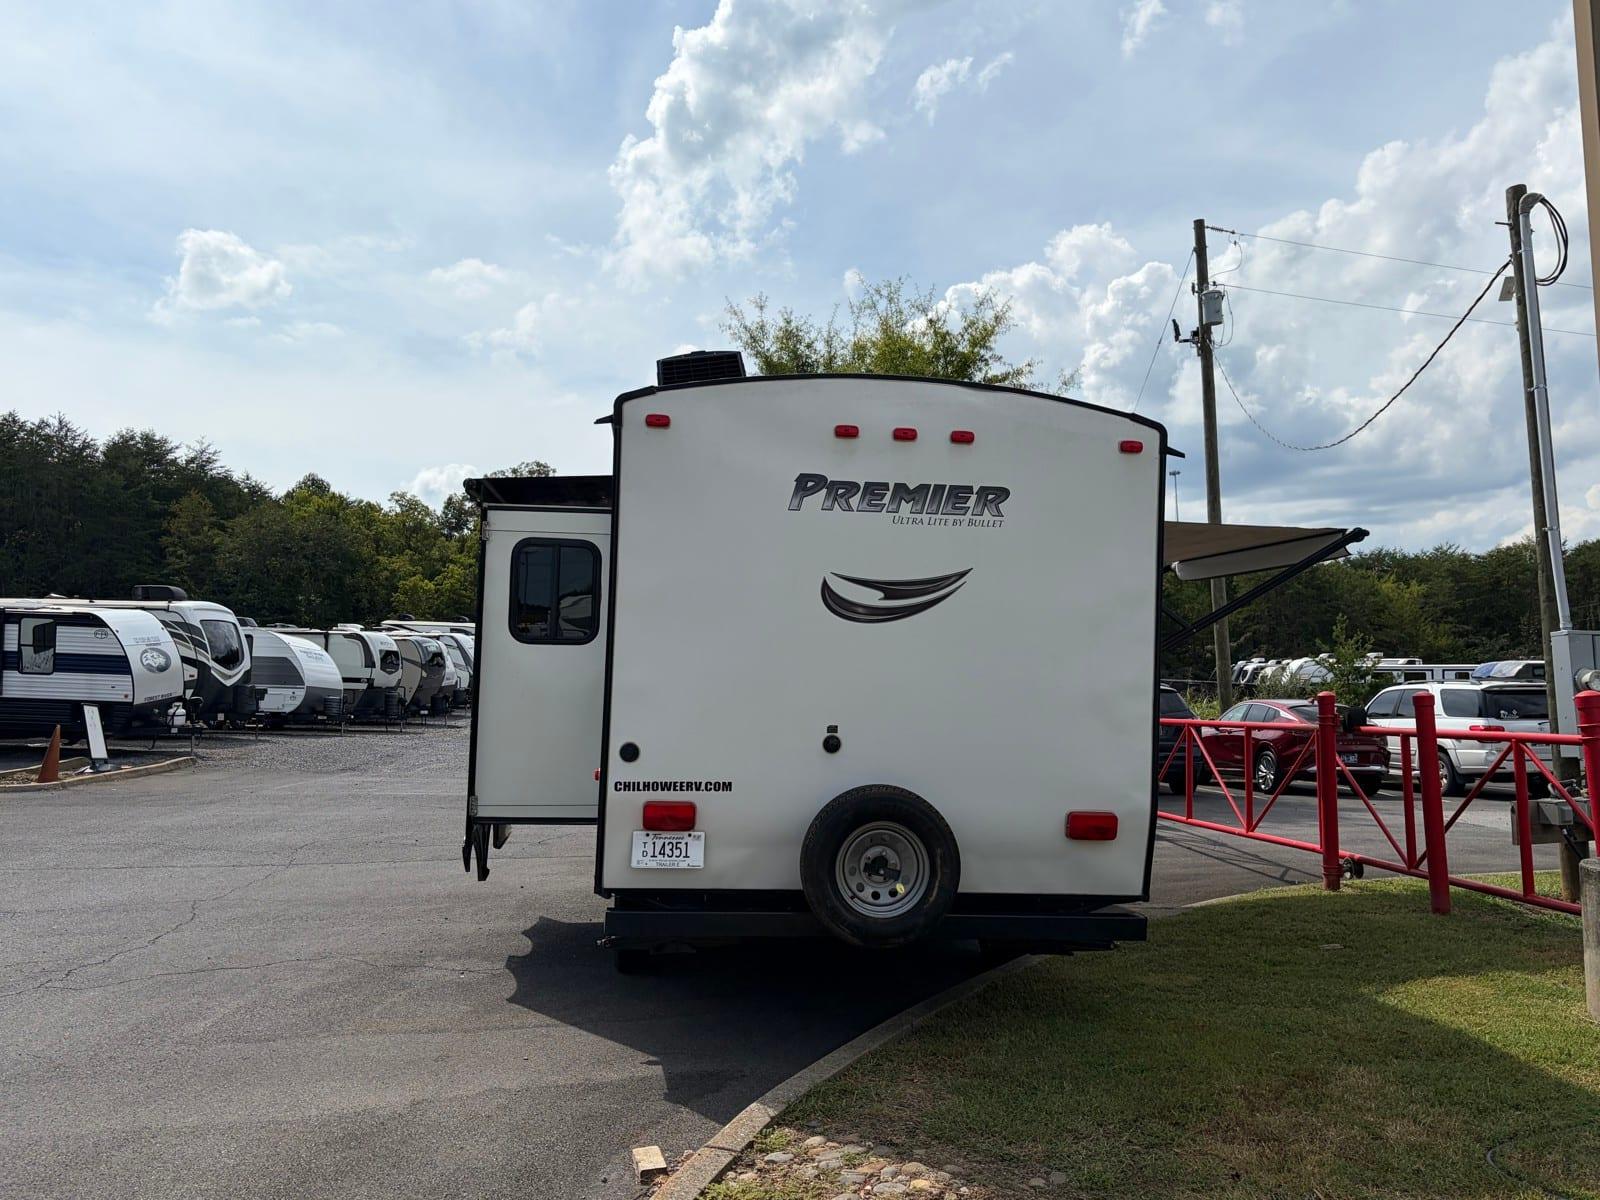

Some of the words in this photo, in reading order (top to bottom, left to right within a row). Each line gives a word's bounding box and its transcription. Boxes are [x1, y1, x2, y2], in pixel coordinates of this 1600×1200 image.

[788, 473, 1010, 517] PREMIER
[892, 515, 924, 526] ULTRA
[928, 516, 950, 527] LITE
[952, 518, 965, 527] BY
[967, 517, 1005, 529] BULLET
[614, 781, 733, 792] CHILHOWEERV.COM
[650, 841, 690, 859] 14351
